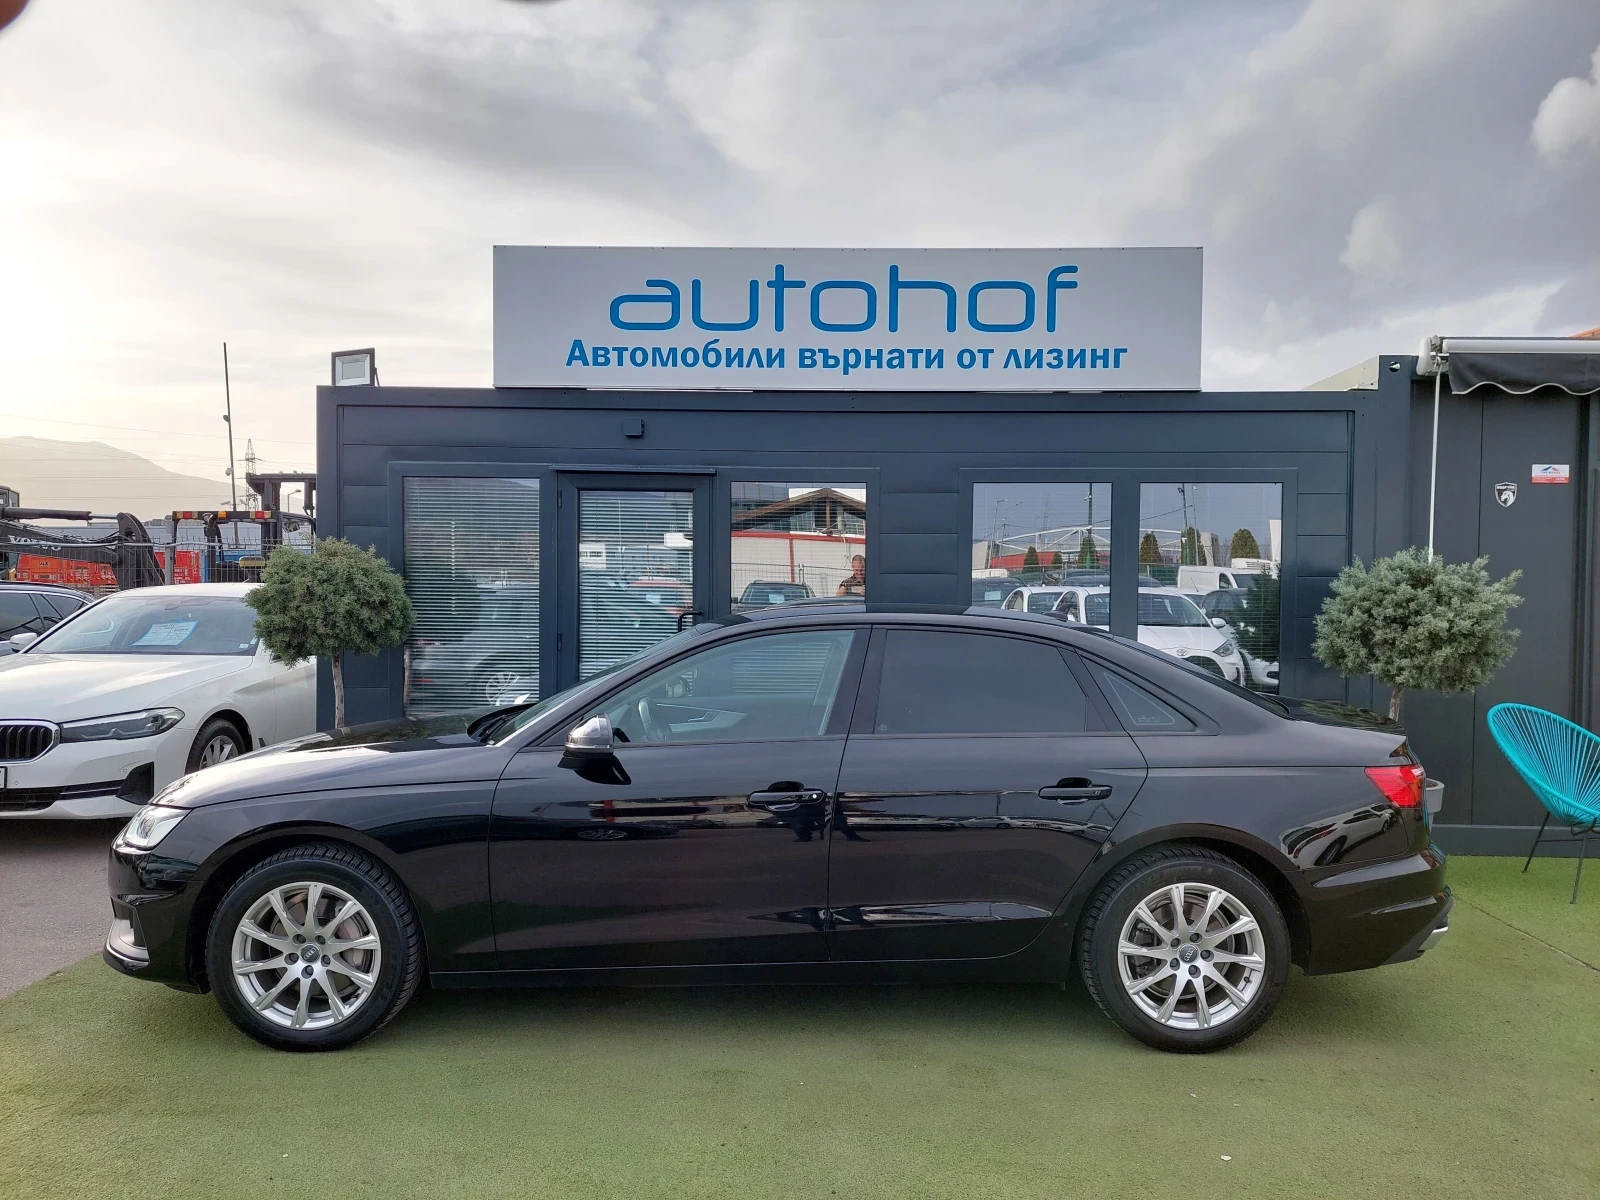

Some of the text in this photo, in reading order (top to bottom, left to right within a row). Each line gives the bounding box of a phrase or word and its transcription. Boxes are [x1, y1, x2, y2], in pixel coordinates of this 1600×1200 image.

[610, 264, 1078, 333] autohof
[566, 339, 1128, 376] Автомобили върнати от лизинг
